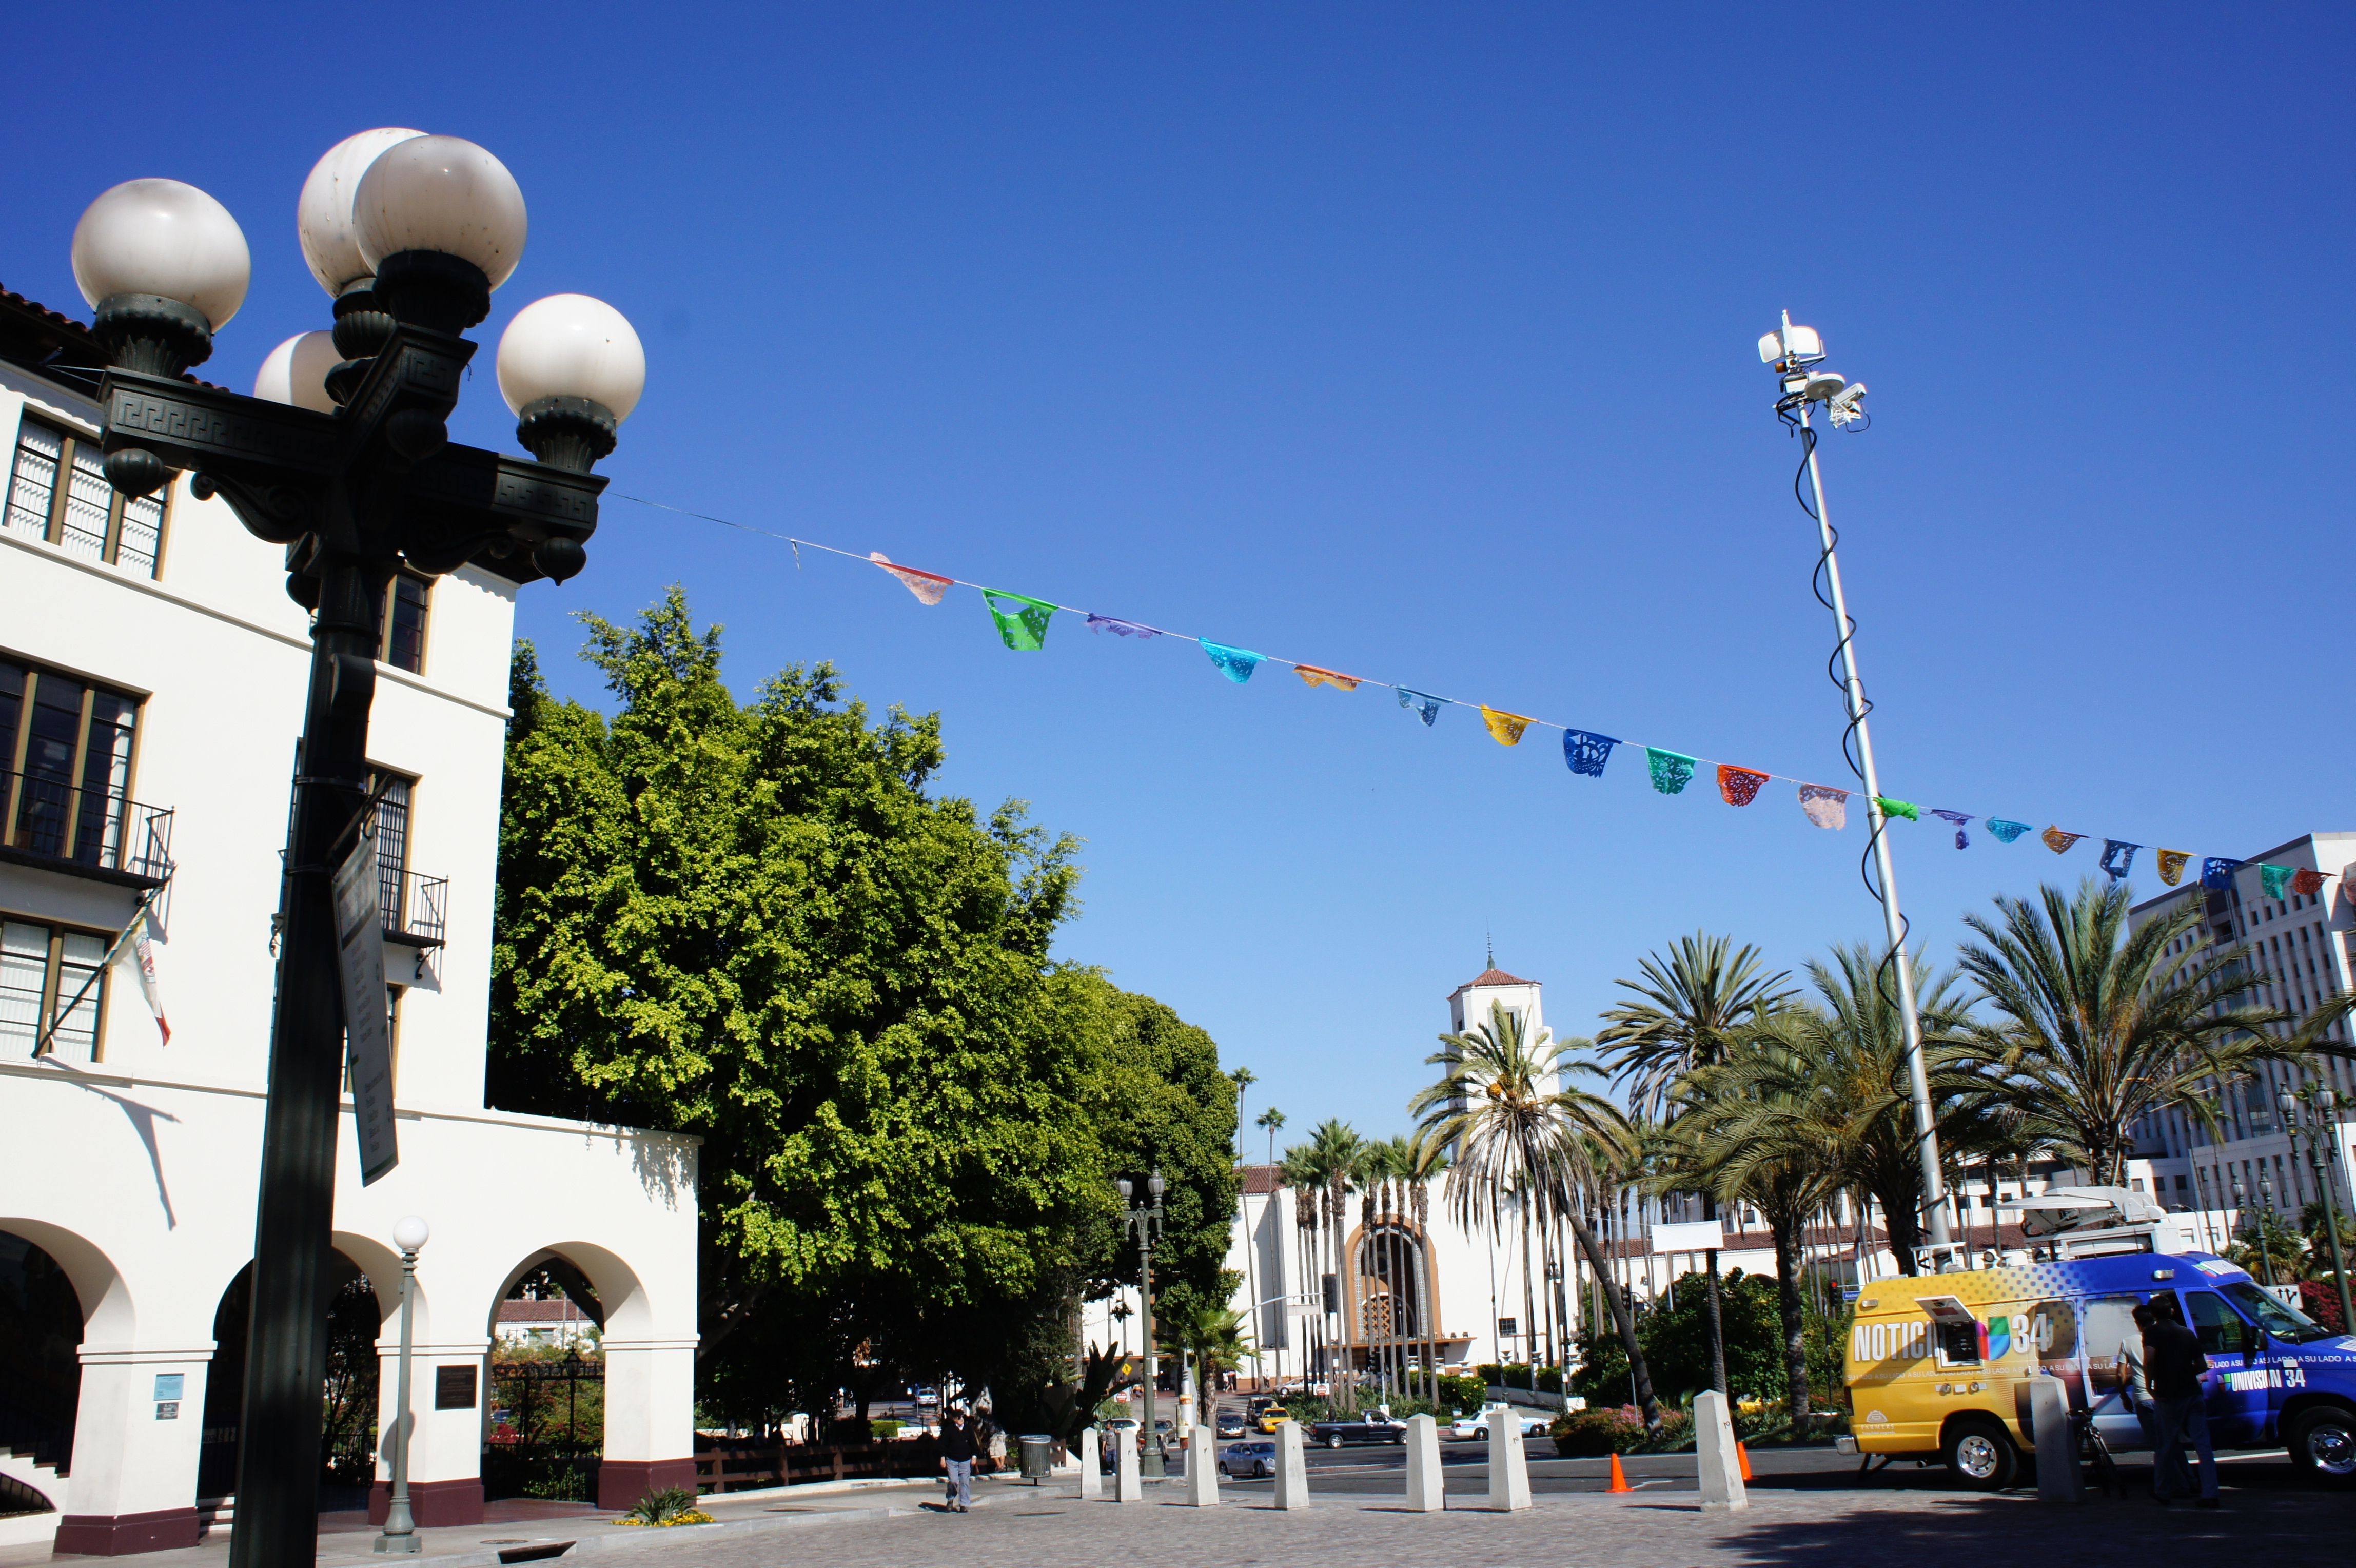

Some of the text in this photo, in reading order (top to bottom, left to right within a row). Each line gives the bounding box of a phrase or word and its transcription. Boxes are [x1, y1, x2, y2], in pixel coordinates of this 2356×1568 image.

[1855, 1313, 2049, 1361] NOTICI 34
[2284, 1368, 2306, 1388] 34
